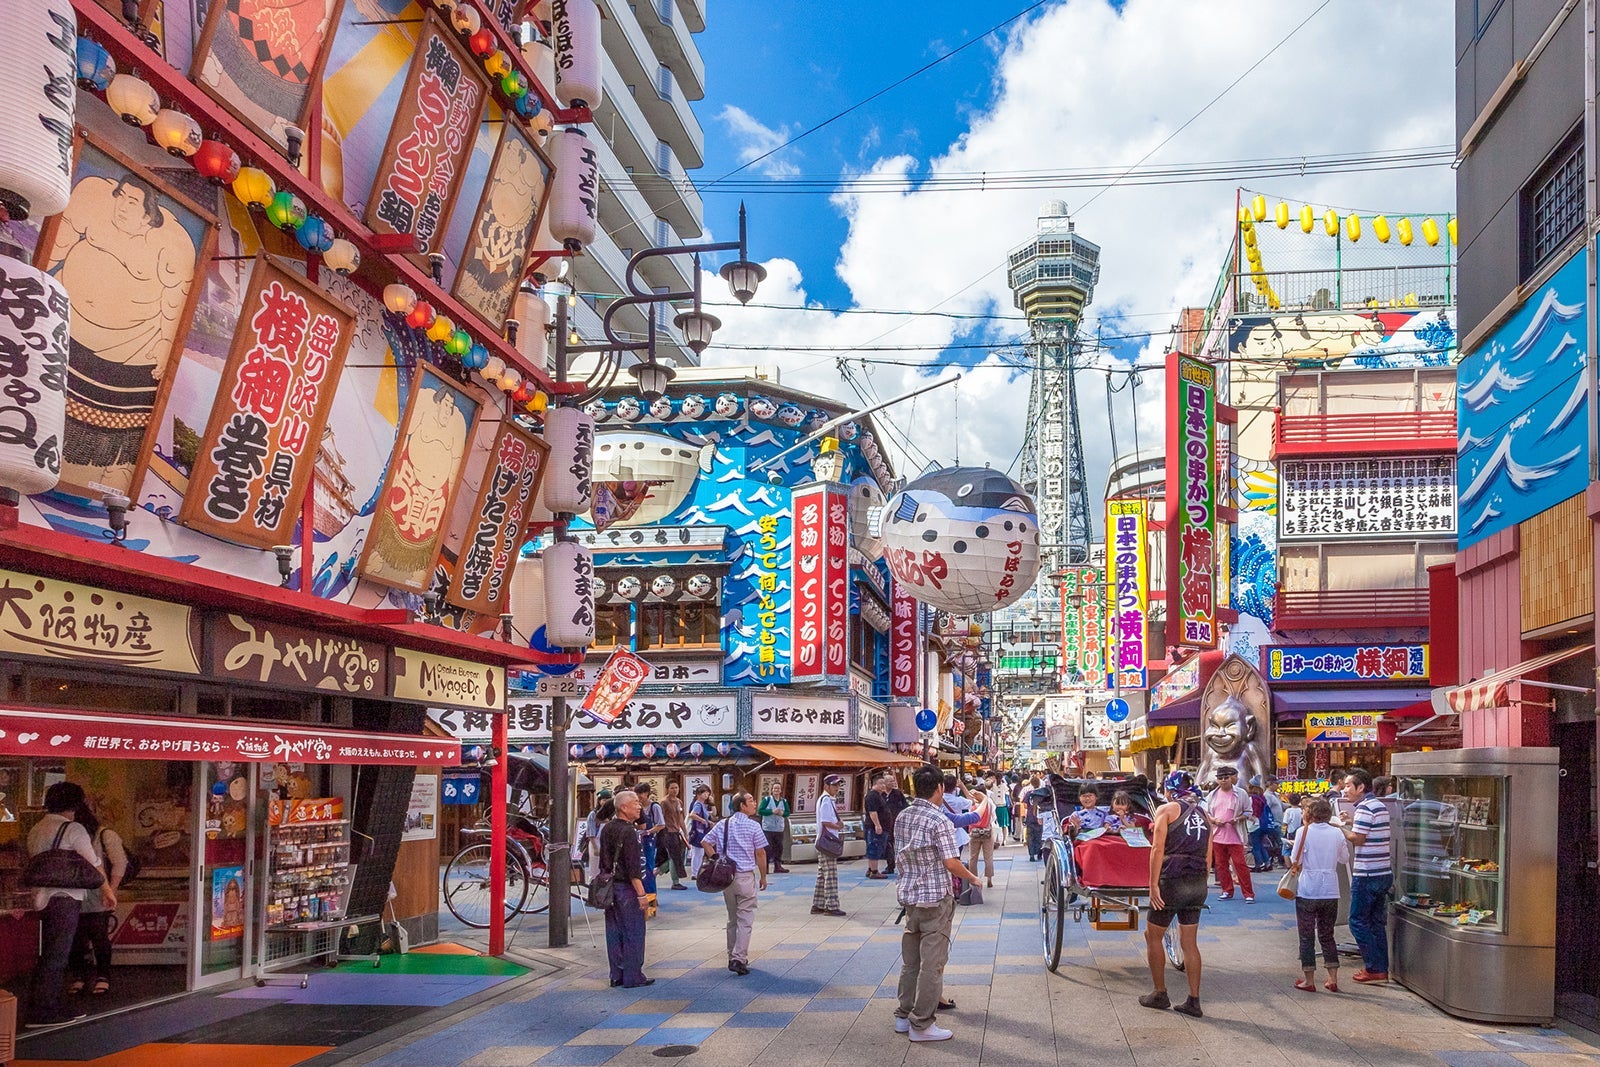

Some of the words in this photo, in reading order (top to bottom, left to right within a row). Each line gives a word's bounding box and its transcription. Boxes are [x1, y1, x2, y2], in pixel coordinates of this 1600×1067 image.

[205, 281, 310, 522] 横綱巻き
[1186, 384, 1208, 525] 日本一の串かつ
[462, 433, 526, 600] 揚げたこ焼き
[800, 503, 818, 548] 名物
[829, 503, 846, 547] 名物
[1285, 498, 1296, 534] もち
[1309, 497, 1320, 533] 紅しょうが
[1320, 497, 1332, 533] にんにく
[1332, 496, 1344, 533] 玉ねぎ
[1344, 496, 1356, 532] 山芋
[1356, 496, 1368, 532] しし唐
[1368, 495, 1380, 532] れんこん
[1380, 495, 1392, 531] 銀杏
[1392, 494, 1404, 531] 白ねぎ
[1404, 494, 1415, 531] さつま芋
[1416, 494, 1428, 530] じゃが芋
[1428, 493, 1440, 530] 茄子
[1181, 523, 1213, 620] 横綱
[0, 579, 153, 651] 大阪物産
[1185, 620, 1211, 642] 酒処
[224, 614, 369, 692] みやげ堂
[437, 664, 457, 676] Osaka
[1283, 655, 1354, 672] 日本一の串かつ
[1355, 647, 1410, 678] 横綱
[1409, 647, 1424, 676] 酒処
[655, 665, 709, 680] 日本一
[1276, 781, 1331, 794] 阪新世界
